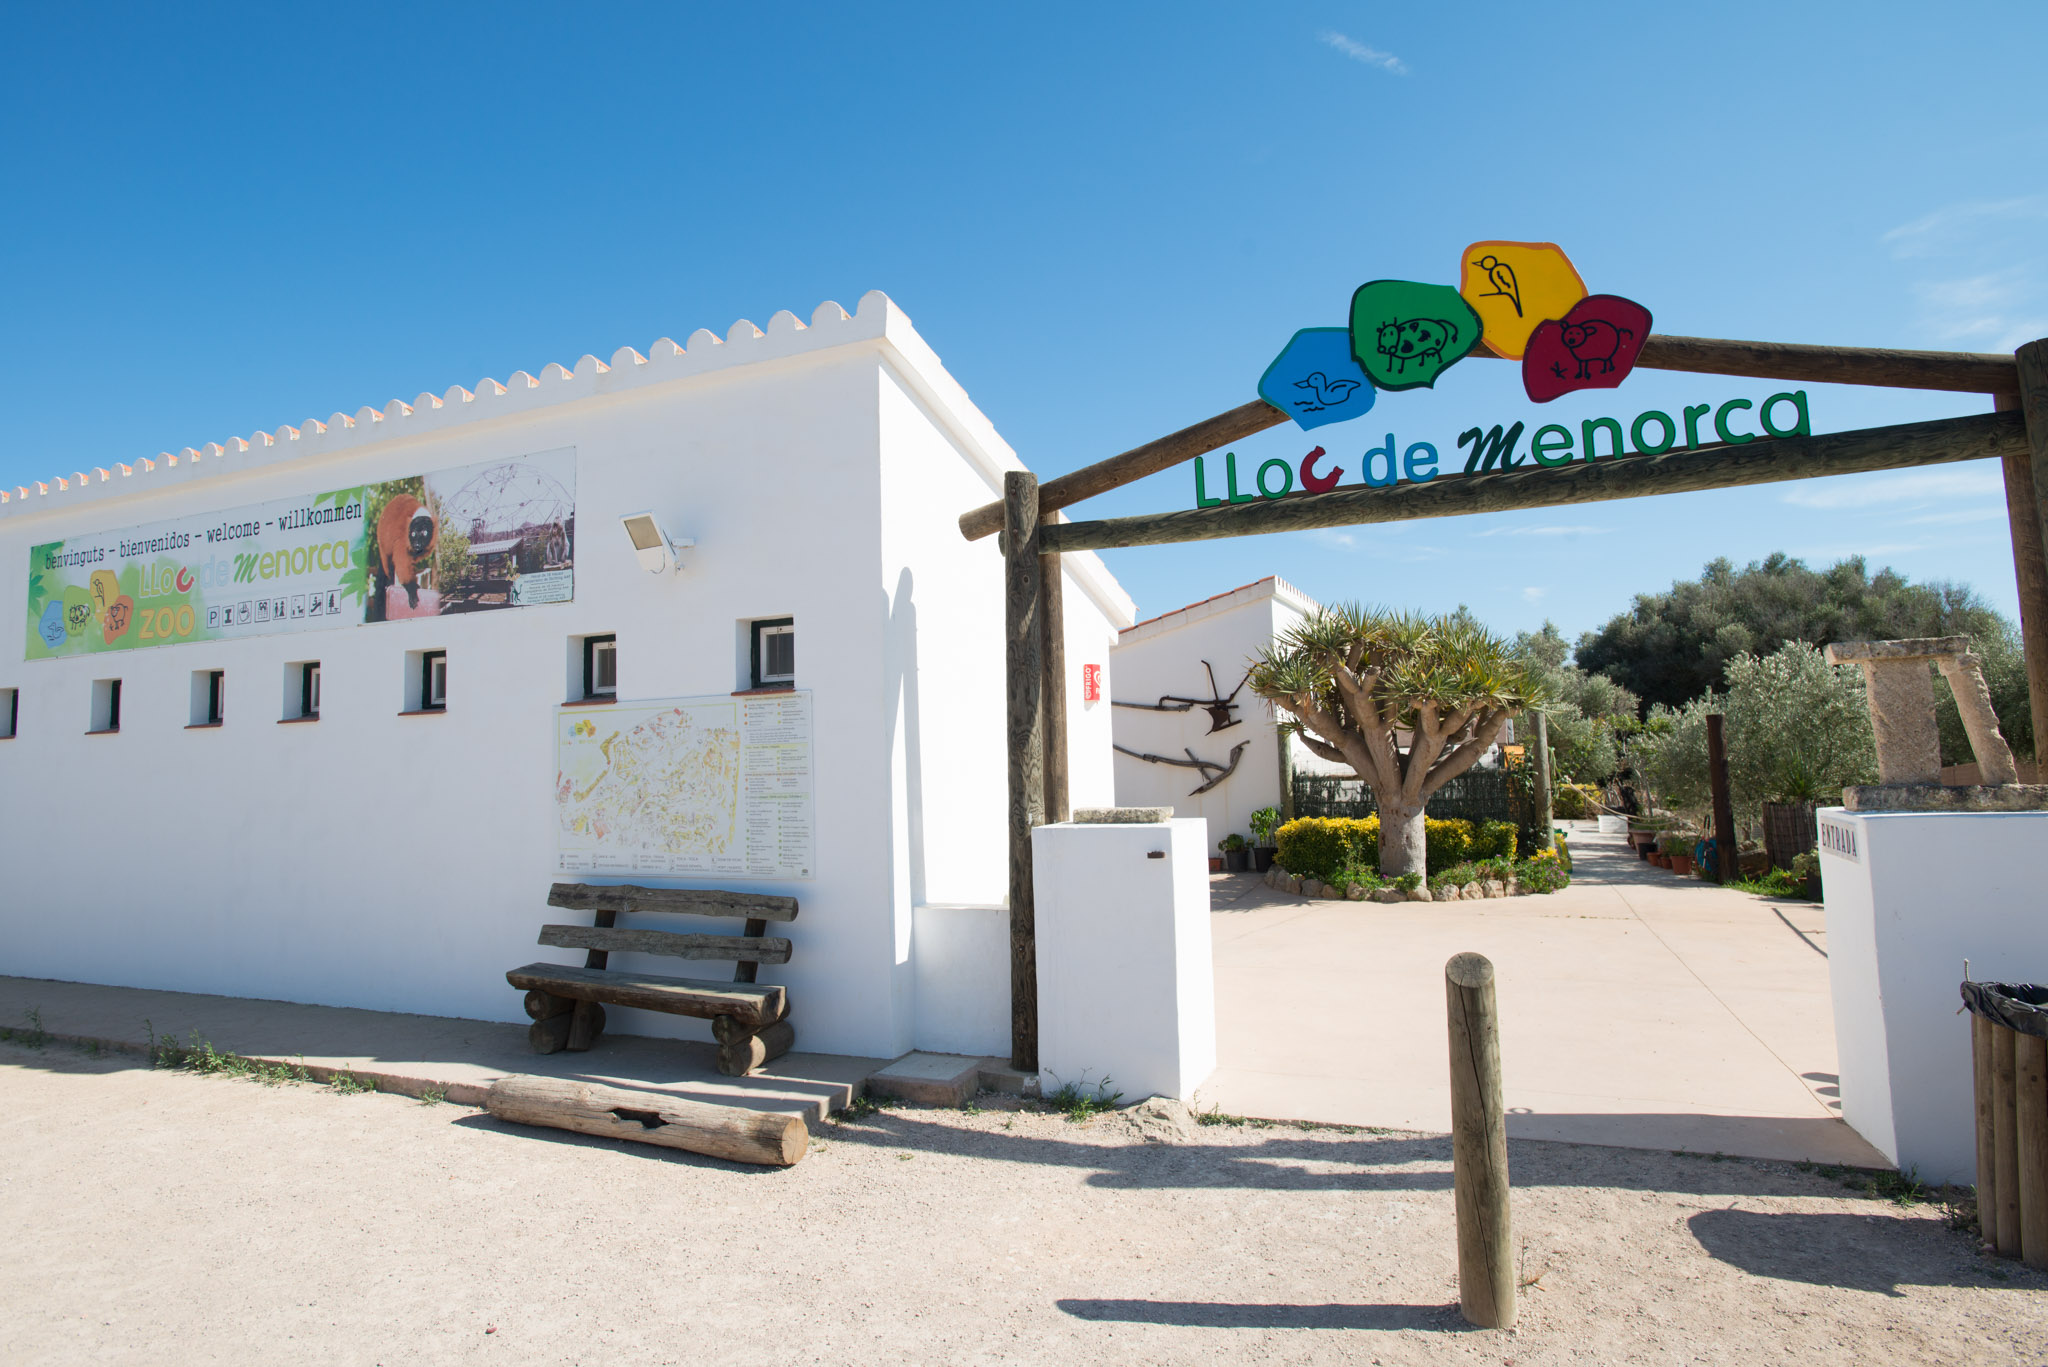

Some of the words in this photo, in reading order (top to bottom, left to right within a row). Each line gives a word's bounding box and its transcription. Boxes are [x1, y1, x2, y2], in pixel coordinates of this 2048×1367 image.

[1362, 433, 1438, 488] de
[1458, 390, 1811, 477] Menorca
[45, 546, 105, 570] benvinguts
[120, 532, 190, 558] bienvenidos
[207, 521, 260, 544] welcome
[279, 503, 362, 532] willkommen
[201, 554, 229, 588] de
[233, 540, 349, 584] Menorca
[139, 604, 195, 639] ZOO
[1821, 823, 1857, 857] ENTRADA
